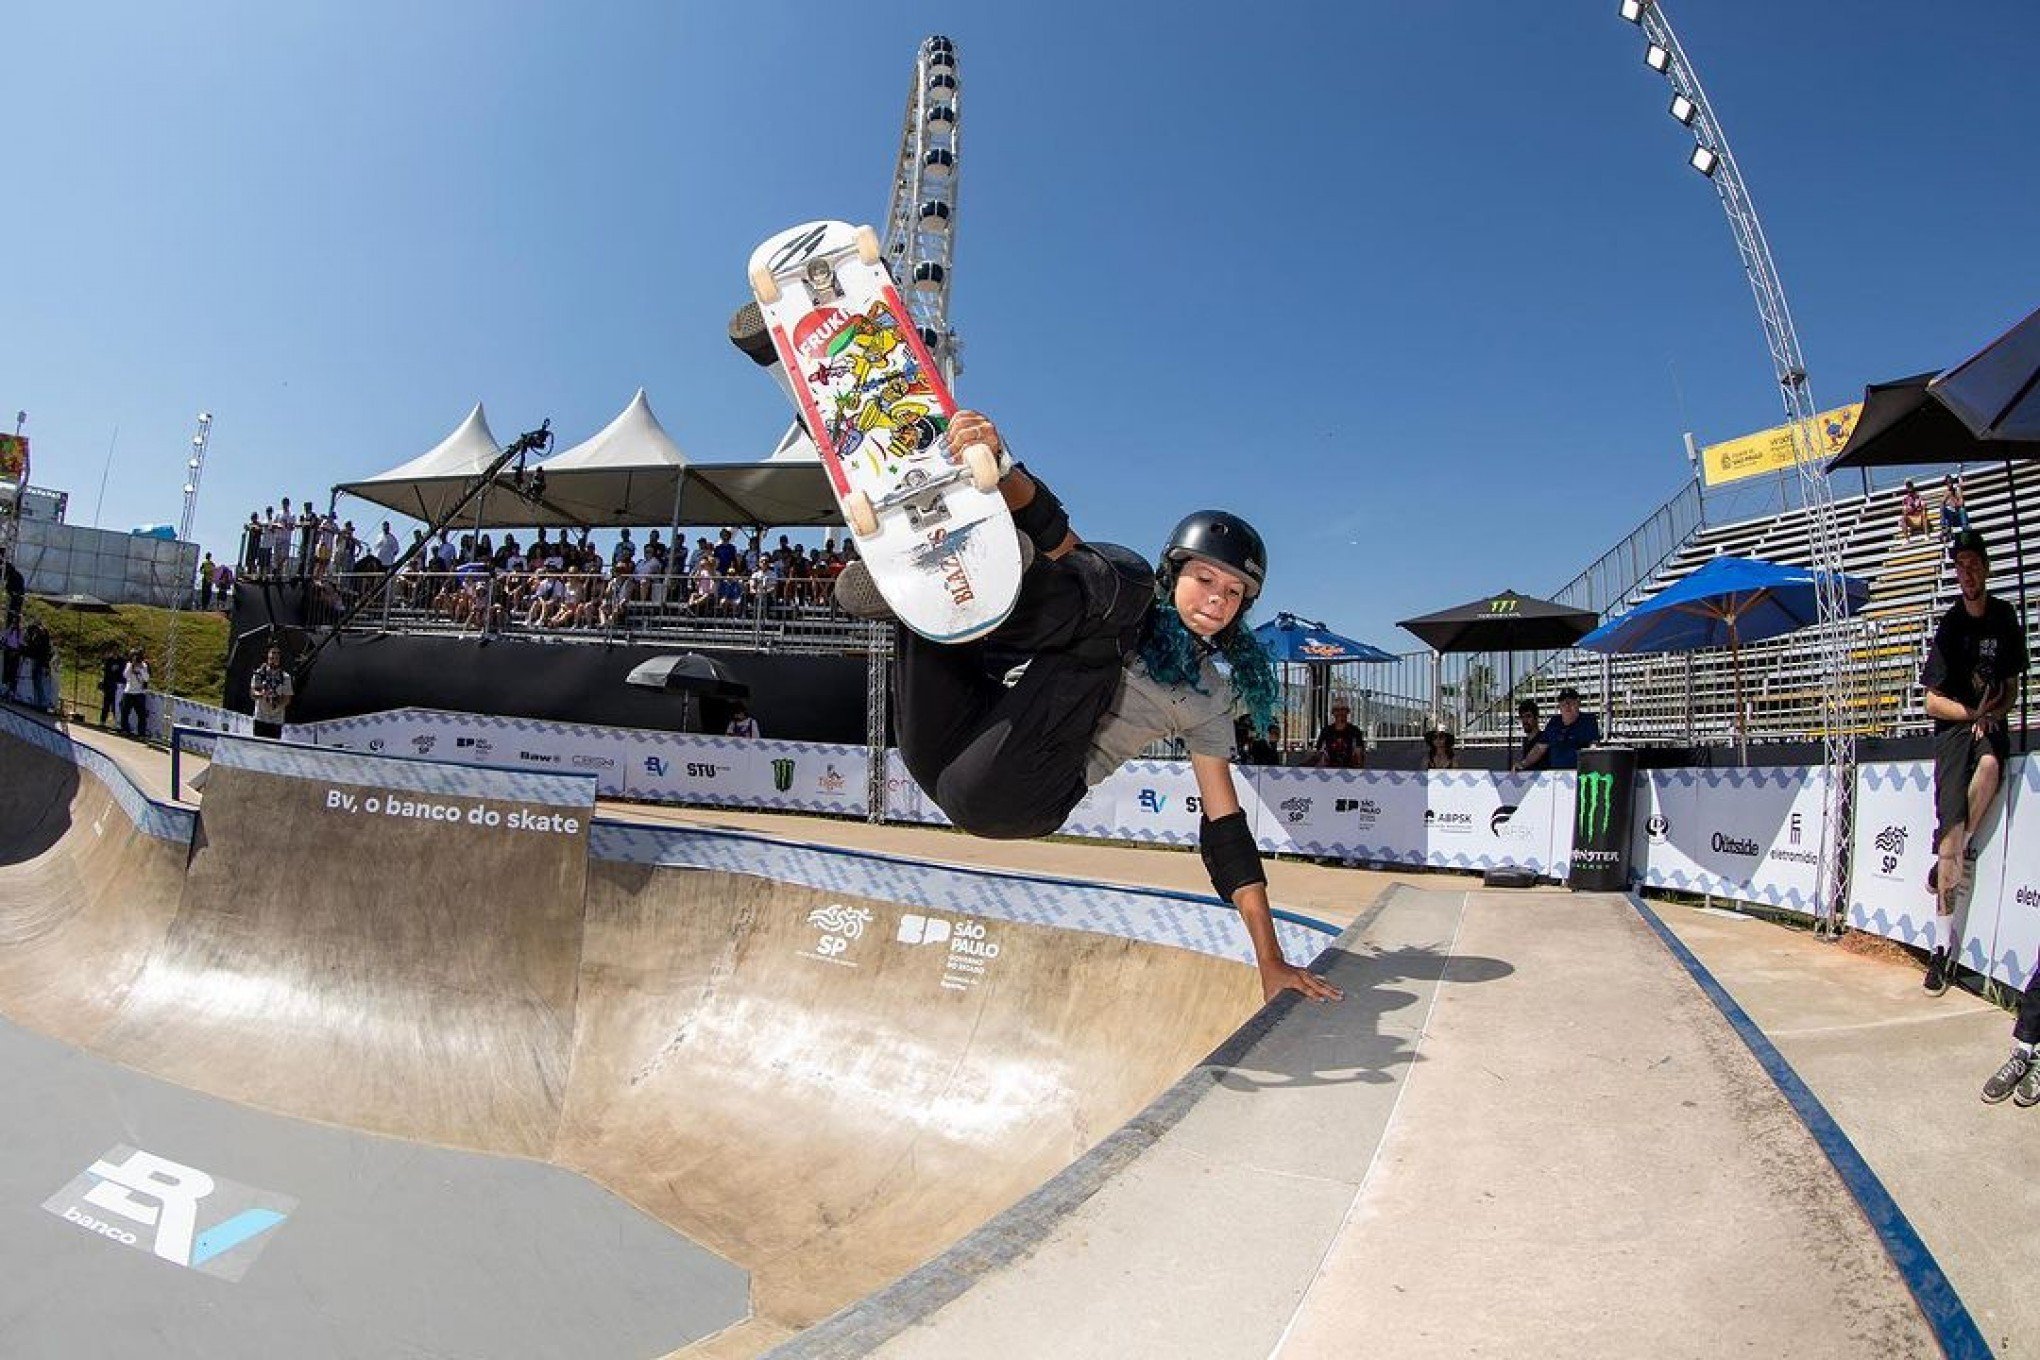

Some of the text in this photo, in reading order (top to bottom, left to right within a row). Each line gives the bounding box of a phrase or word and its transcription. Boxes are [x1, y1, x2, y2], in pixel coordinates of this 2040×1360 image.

[686, 762, 716, 777] STU
[326, 788, 579, 834] Bv, o banco do skate
[954, 919, 987, 940] SÃO
[951, 937, 1000, 958] PAULO
[61, 1205, 138, 1246] banco
